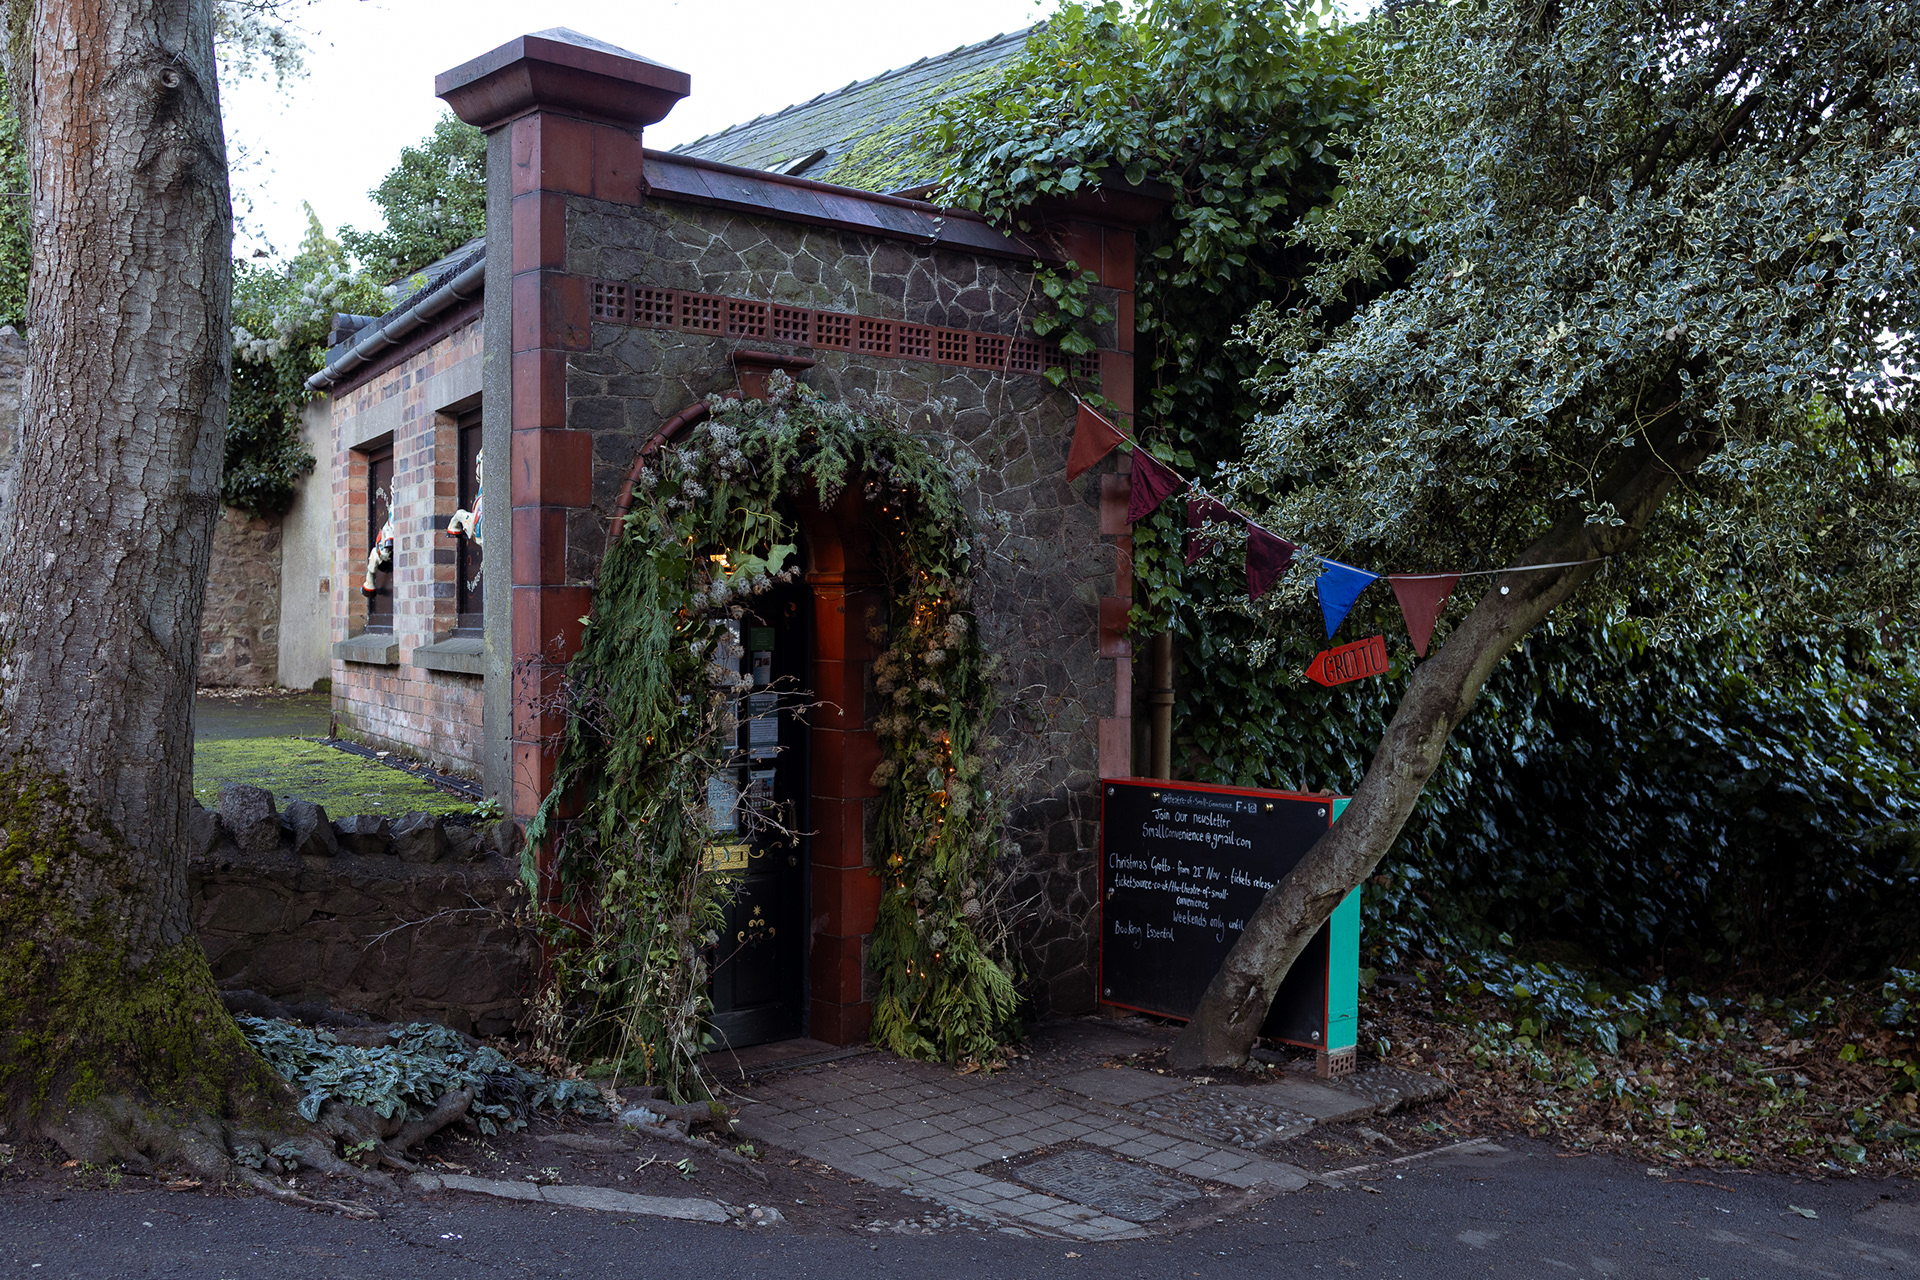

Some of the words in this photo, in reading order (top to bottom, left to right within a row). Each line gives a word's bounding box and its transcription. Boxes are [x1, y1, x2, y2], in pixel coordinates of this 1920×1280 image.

[1322, 642, 1383, 683] GROTTO
[1151, 807, 1171, 821] Join
[1192, 811, 1231, 828] newsletter
[1109, 852, 1148, 871] Christmas
[1150, 856, 1171, 876] Grotto
[1177, 860, 1190, 876] from
[1205, 866, 1221, 881] Nov
[1230, 868, 1251, 887] tickets
[1253, 876, 1280, 889] release
[1115, 920, 1142, 949] Booking
[1146, 923, 1175, 942] Essential
[1172, 909, 1207, 928] Weekends
[1210, 914, 1225, 943] only
[1228, 919, 1245, 932] until
